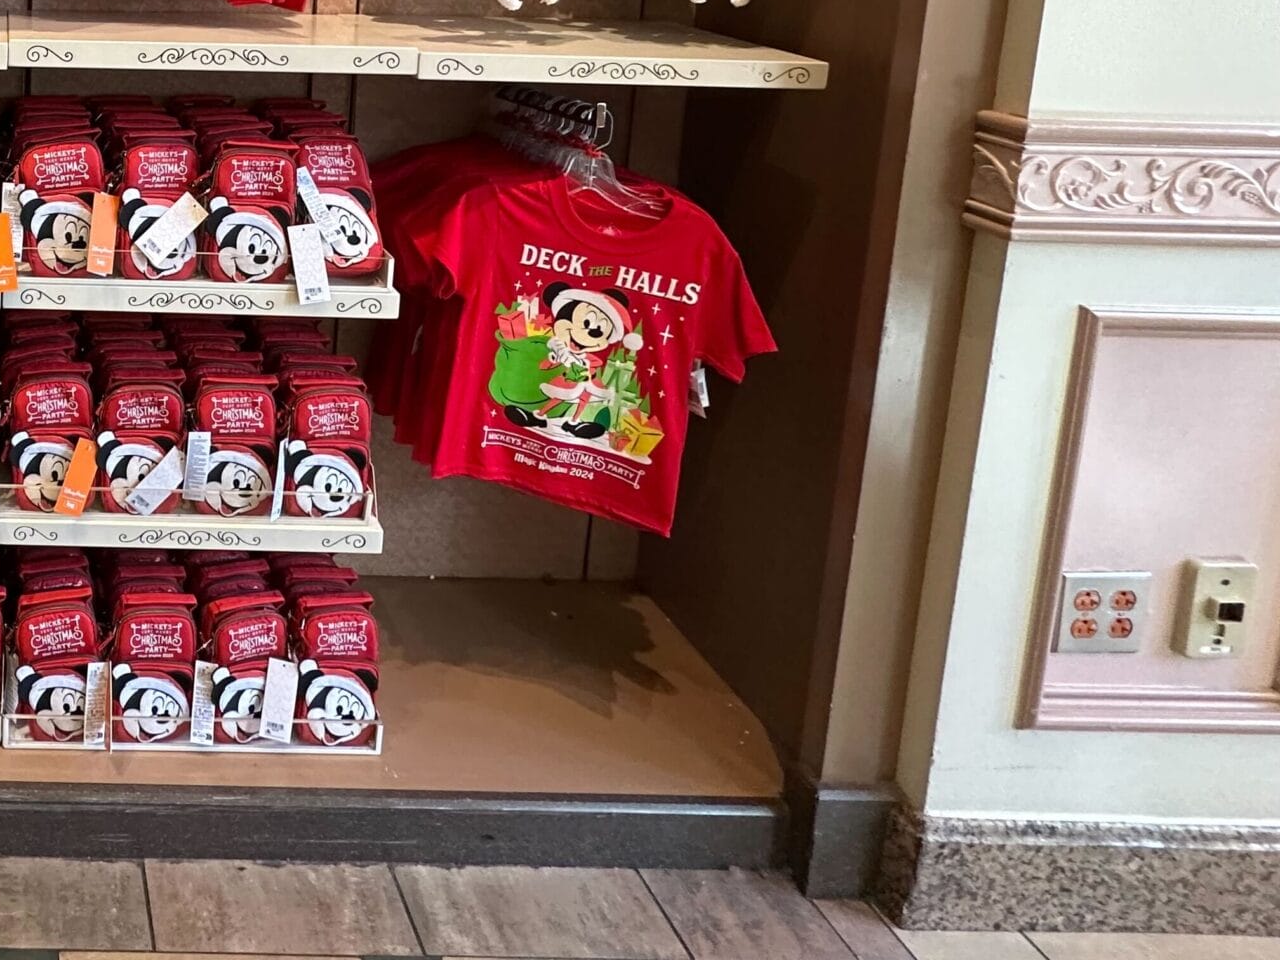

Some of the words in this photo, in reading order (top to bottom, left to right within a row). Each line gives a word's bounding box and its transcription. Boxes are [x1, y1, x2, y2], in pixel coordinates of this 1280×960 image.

[34, 158, 88, 178] CHRISTMAS
[138, 161, 188, 177] CHRISTMAS
[308, 153, 355, 169] CHRISTMAS
[52, 174, 75, 183] PARTY
[231, 170, 284, 185] CHRISTMAS
[520, 243, 588, 278] DECK
[588, 265, 615, 278] THE
[615, 265, 702, 306] HALLS
[26, 398, 79, 416] CHRISTMAS
[42, 411, 66, 419] PARTY
[116, 405, 169, 421] CHRISTMAS
[211, 407, 264, 423] CHRISTMAS
[308, 411, 359, 430] CHRISTMAS
[544, 445, 606, 471] CHRISTMAS
[607, 463, 636, 480] PARTY
[569, 467, 595, 481] 2024
[30, 626, 84, 649] CHRISTMAS
[130, 633, 182, 649] CHRISTMAS
[229, 631, 278, 654] CHRISTMAS
[317, 631, 367, 647] CHRISTMAS
[47, 642, 72, 651] PARTY
[144, 646, 168, 654] PARTY
